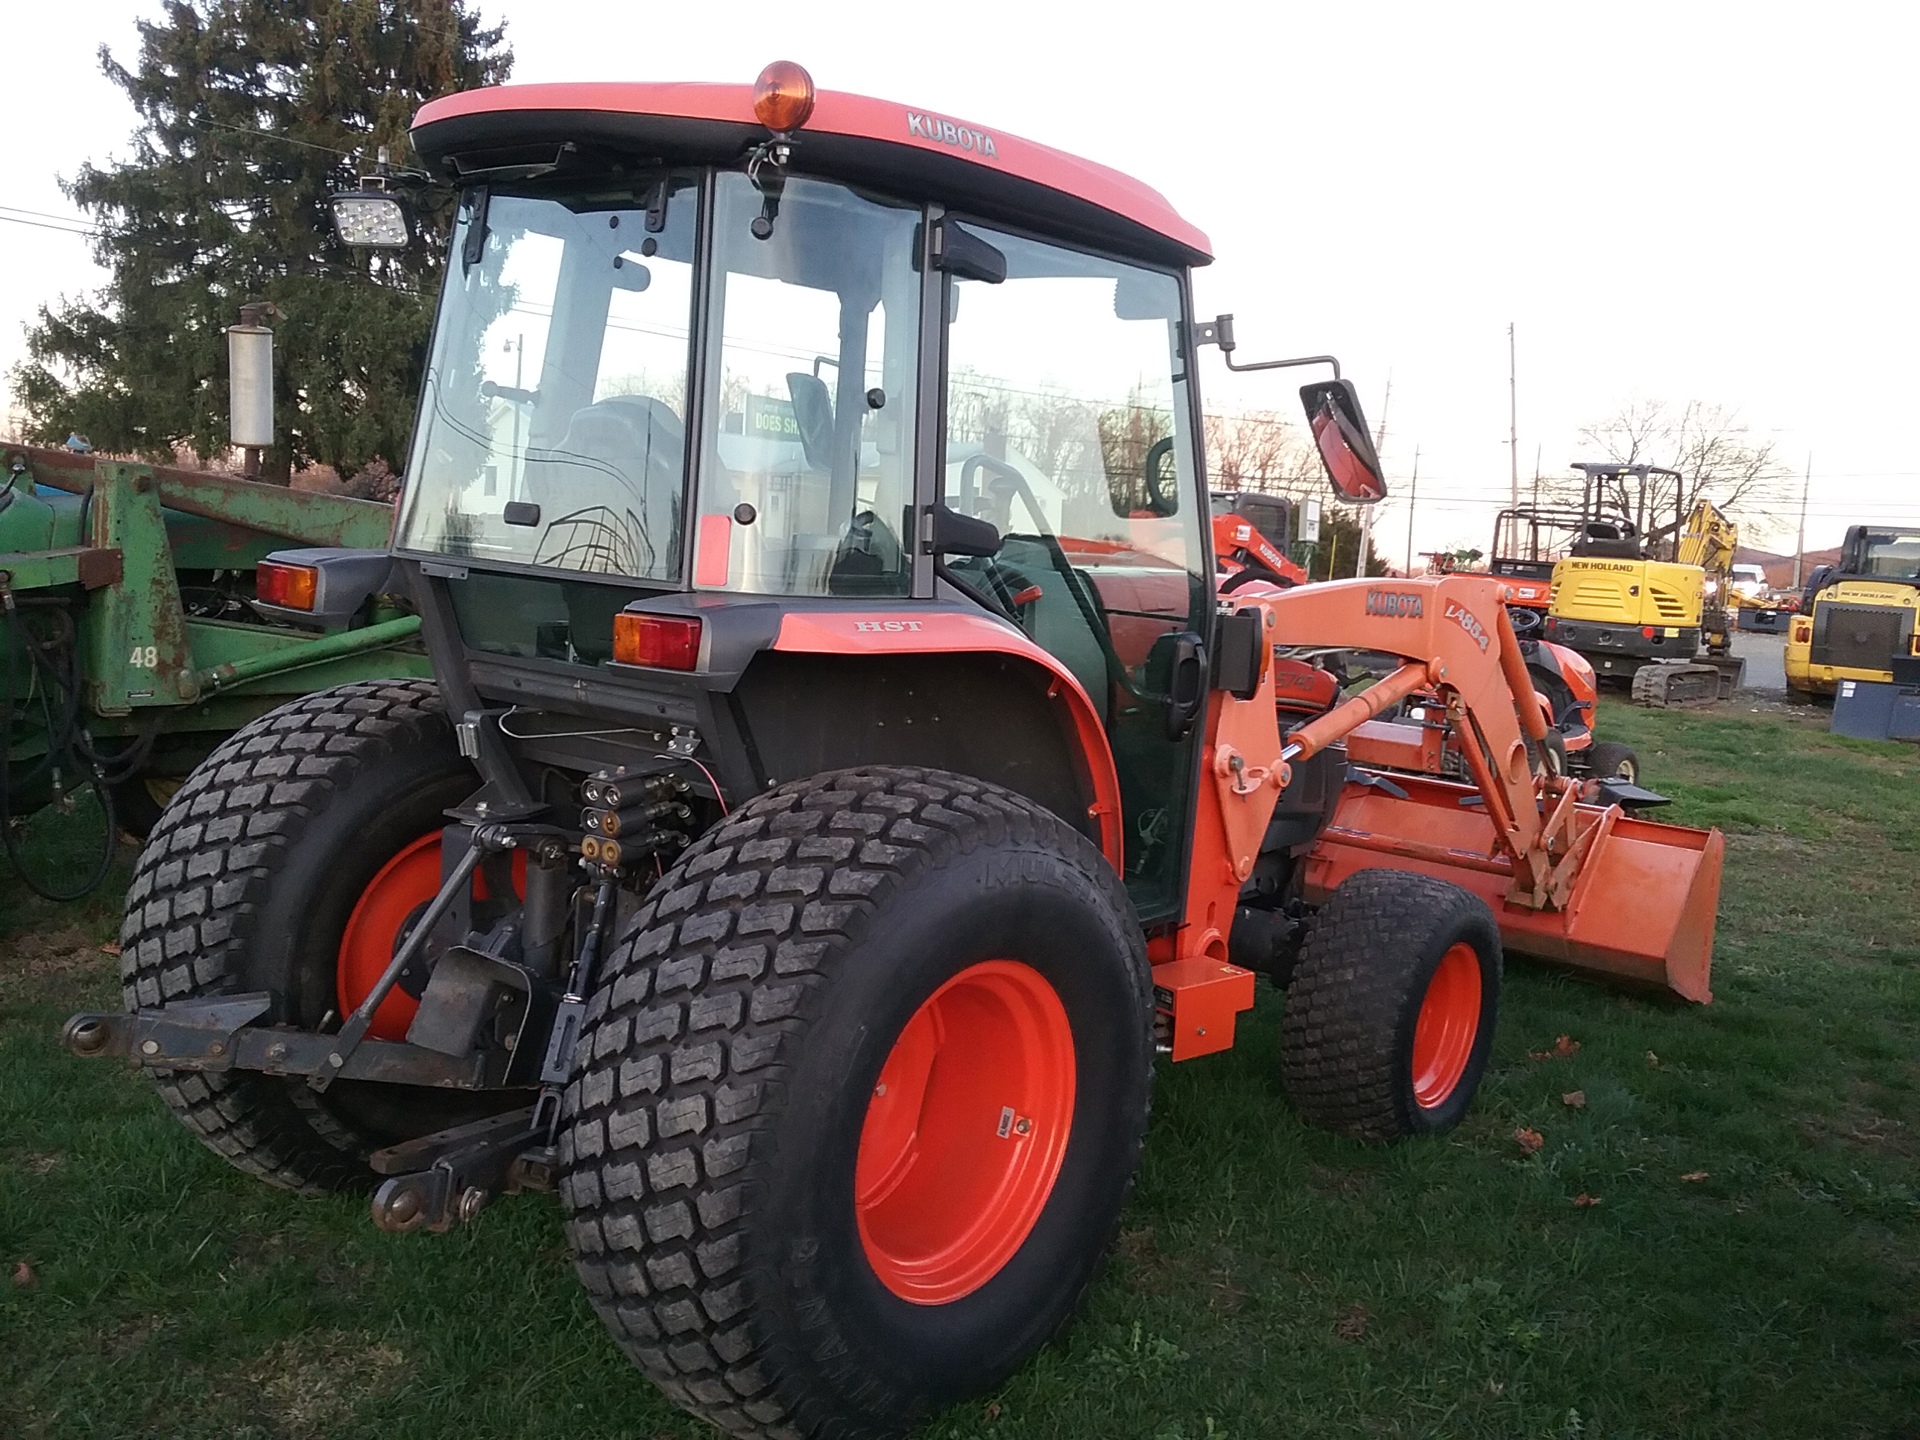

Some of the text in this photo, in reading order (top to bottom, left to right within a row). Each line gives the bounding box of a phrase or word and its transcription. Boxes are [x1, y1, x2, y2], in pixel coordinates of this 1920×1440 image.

[907, 111, 999, 160] KUBOTA
[755, 412, 800, 435] DOES SH
[1260, 543, 1282, 569] KUBOTA
[1571, 561, 1633, 572] NEW HOLLAND
[1365, 591, 1424, 618] KUBOTA
[854, 621, 923, 632] HST
[1445, 604, 1490, 651] LA854
[129, 646, 158, 668] 48
